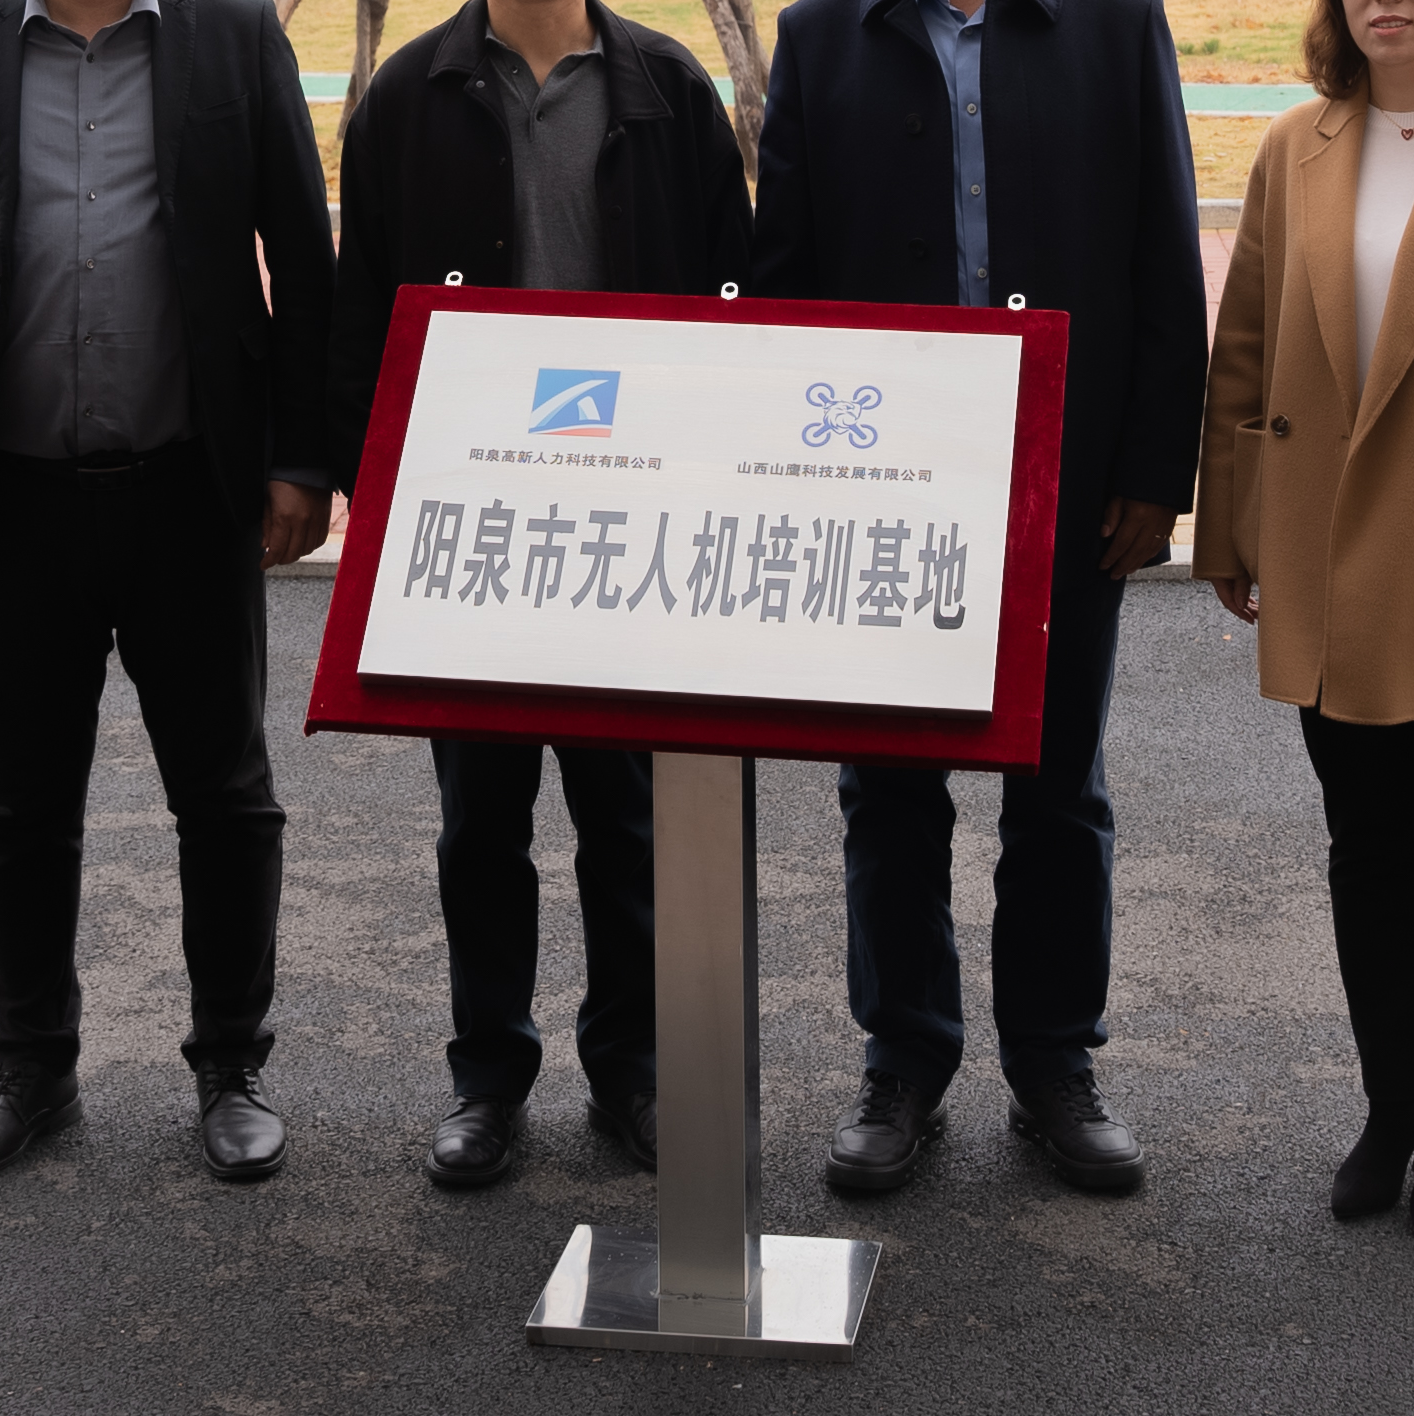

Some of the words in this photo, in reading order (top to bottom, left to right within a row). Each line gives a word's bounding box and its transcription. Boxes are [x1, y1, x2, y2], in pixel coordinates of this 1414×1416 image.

[469, 448, 662, 471] 阳泉高新人力科技有限公司
[737, 461, 933, 483] 山西山鹰科技发展有限公司
[403, 498, 969, 631] 阳泉市无人机培训基地
